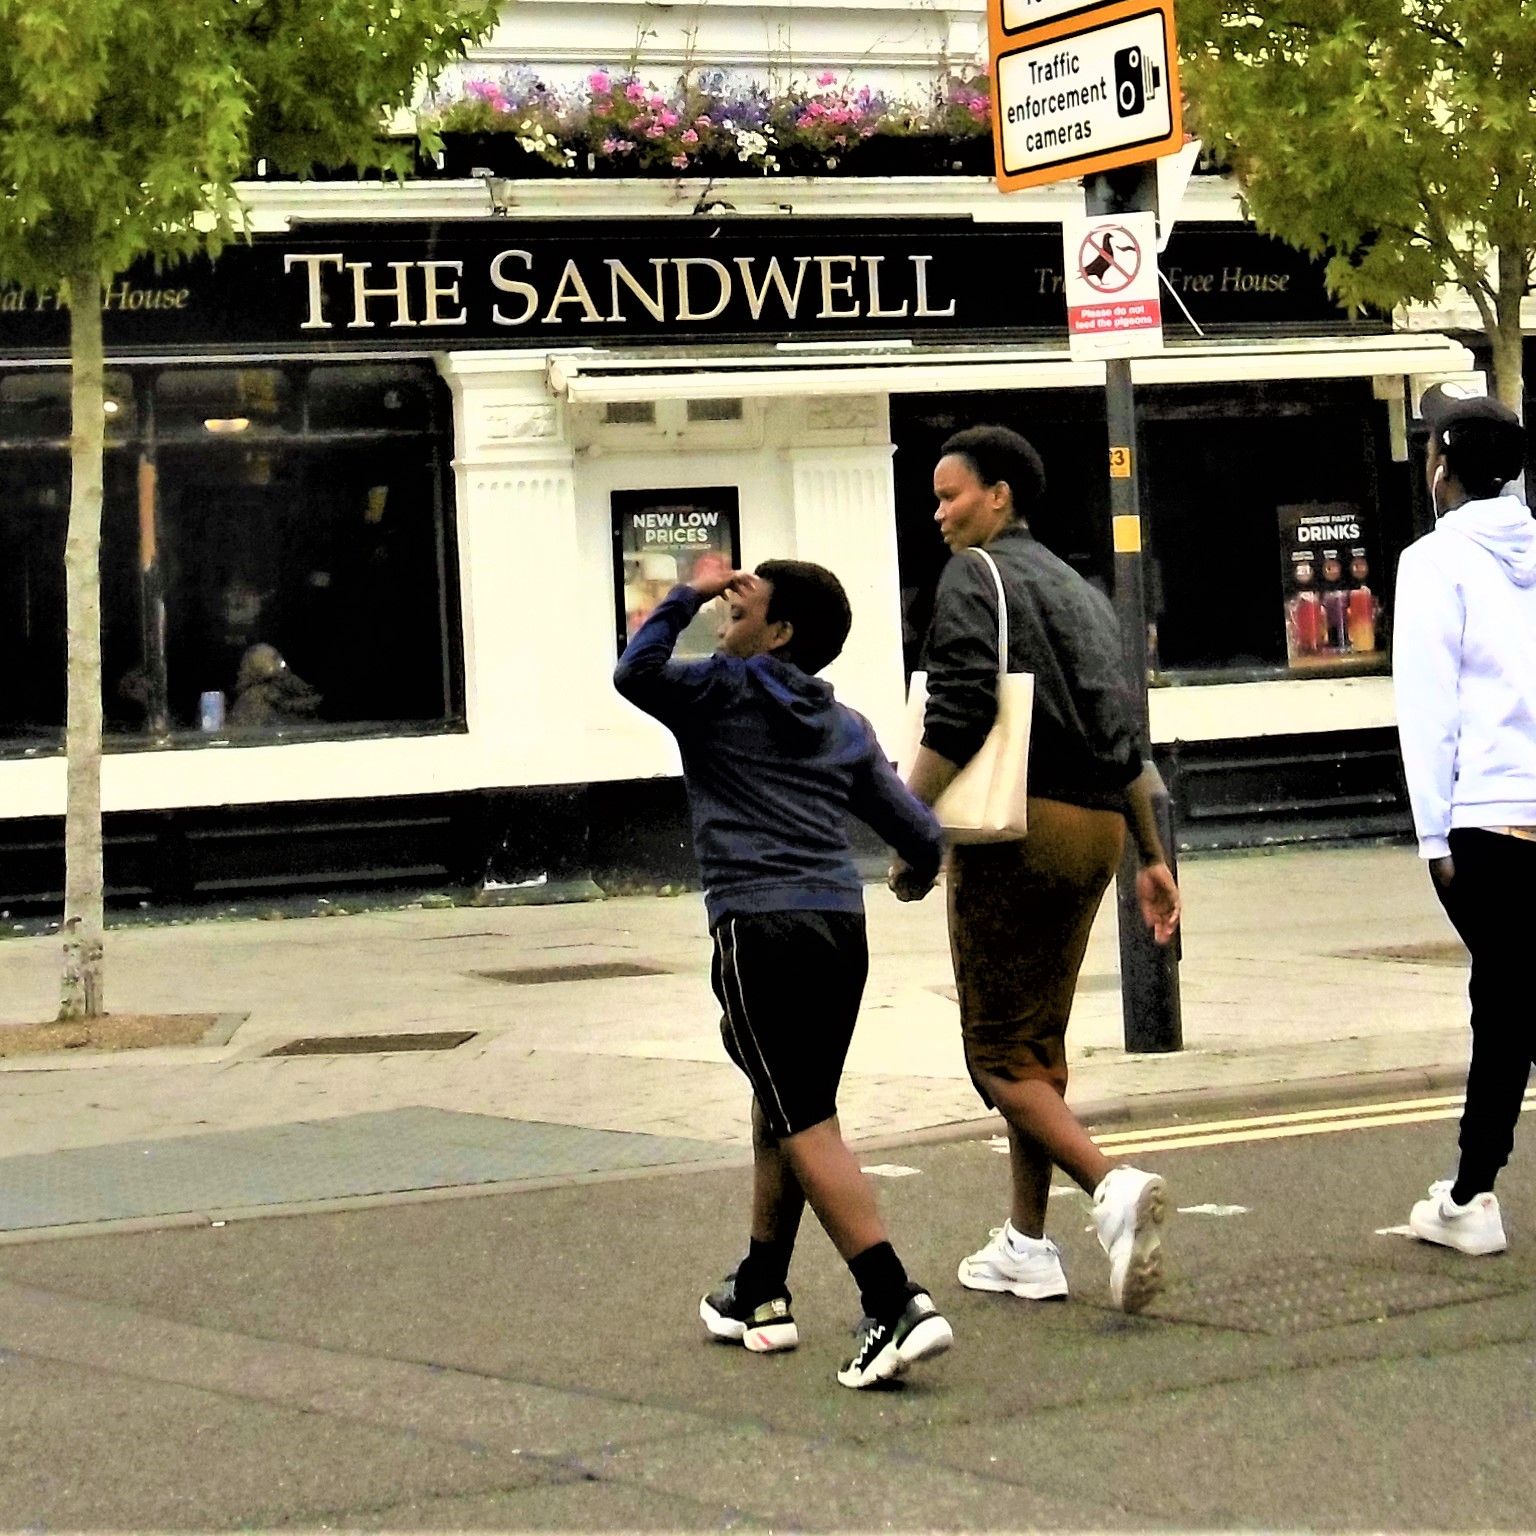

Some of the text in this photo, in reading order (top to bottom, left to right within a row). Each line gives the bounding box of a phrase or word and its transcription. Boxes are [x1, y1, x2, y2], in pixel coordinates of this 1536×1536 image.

[1007, 51, 1108, 124] Traffic enforcement
[1026, 119, 1092, 152] cameras
[284, 249, 957, 329] THE SANDWELL
[1166, 267, 1290, 293] Free House
[103, 281, 190, 312] House
[1080, 305, 1145, 319] Please do not
[1096, 317, 1112, 328] the
[1113, 316, 1153, 328] pigeons
[633, 512, 719, 528] NEW LOW
[645, 528, 708, 543] PRICES
[1297, 524, 1360, 542] DRINKS
